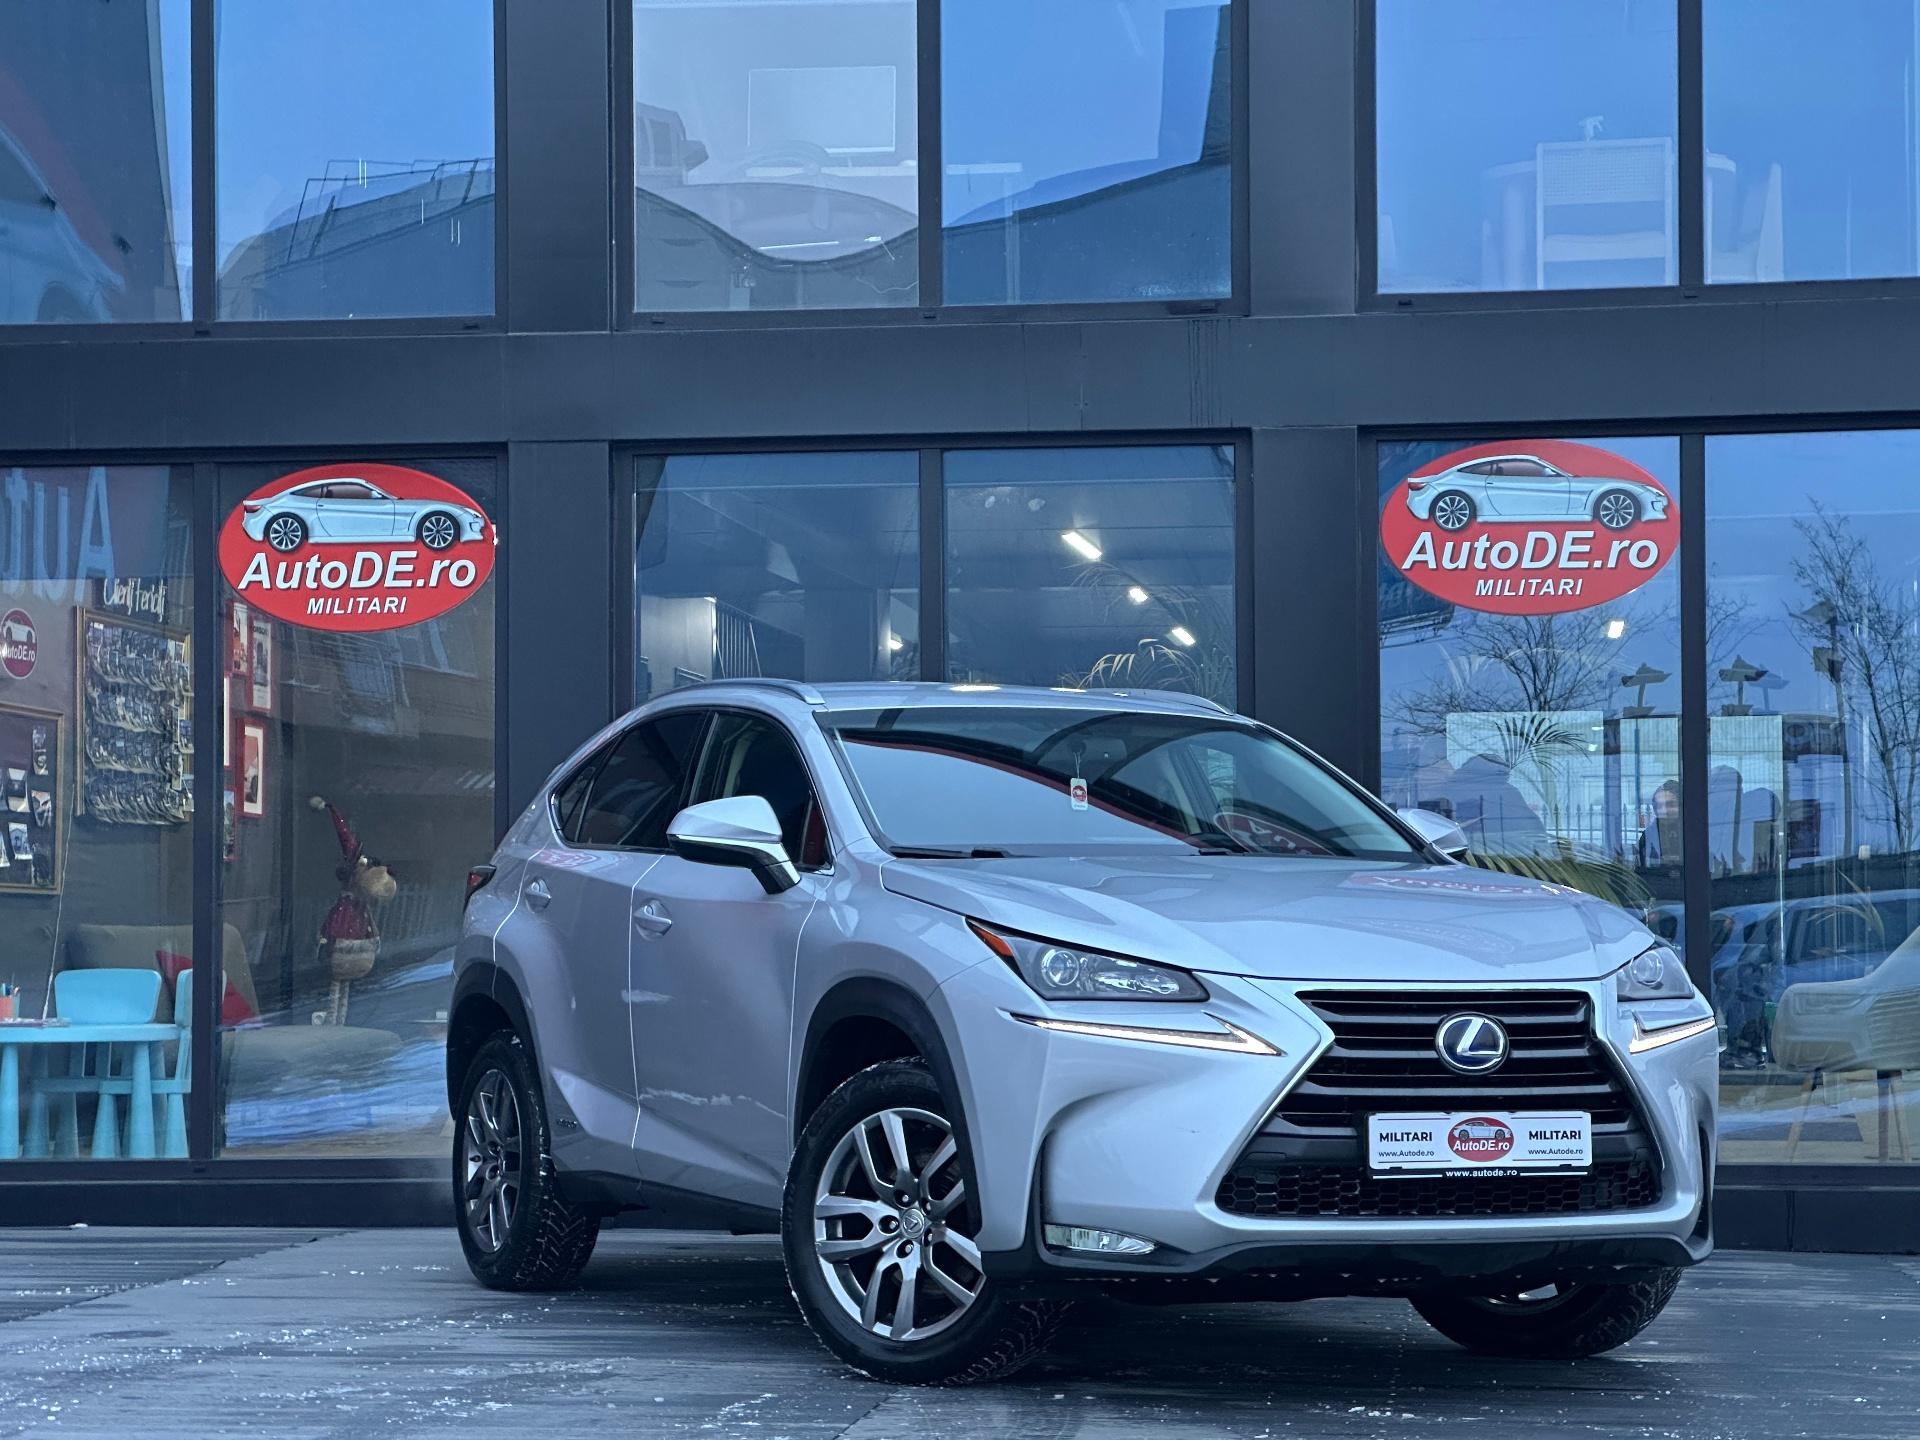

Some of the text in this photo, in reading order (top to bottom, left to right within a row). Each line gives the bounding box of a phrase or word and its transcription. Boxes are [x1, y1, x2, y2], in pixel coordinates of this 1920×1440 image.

[1401, 530, 1660, 570] AutoDE.ro
[237, 551, 477, 591] AutoDE.ro
[1475, 578, 1584, 597] MILITARI
[306, 596, 407, 615] MILITARI
[1379, 1131, 1433, 1142] MILITARI
[1528, 1130, 1582, 1141] MILITARI
[1453, 1140, 1510, 1151] AutoDE.ro
[1378, 1149, 1435, 1157] www.Autode.ro
[1528, 1147, 1584, 1156] www.Autode.ro
[1445, 1168, 1518, 1177] www.autode.ro
